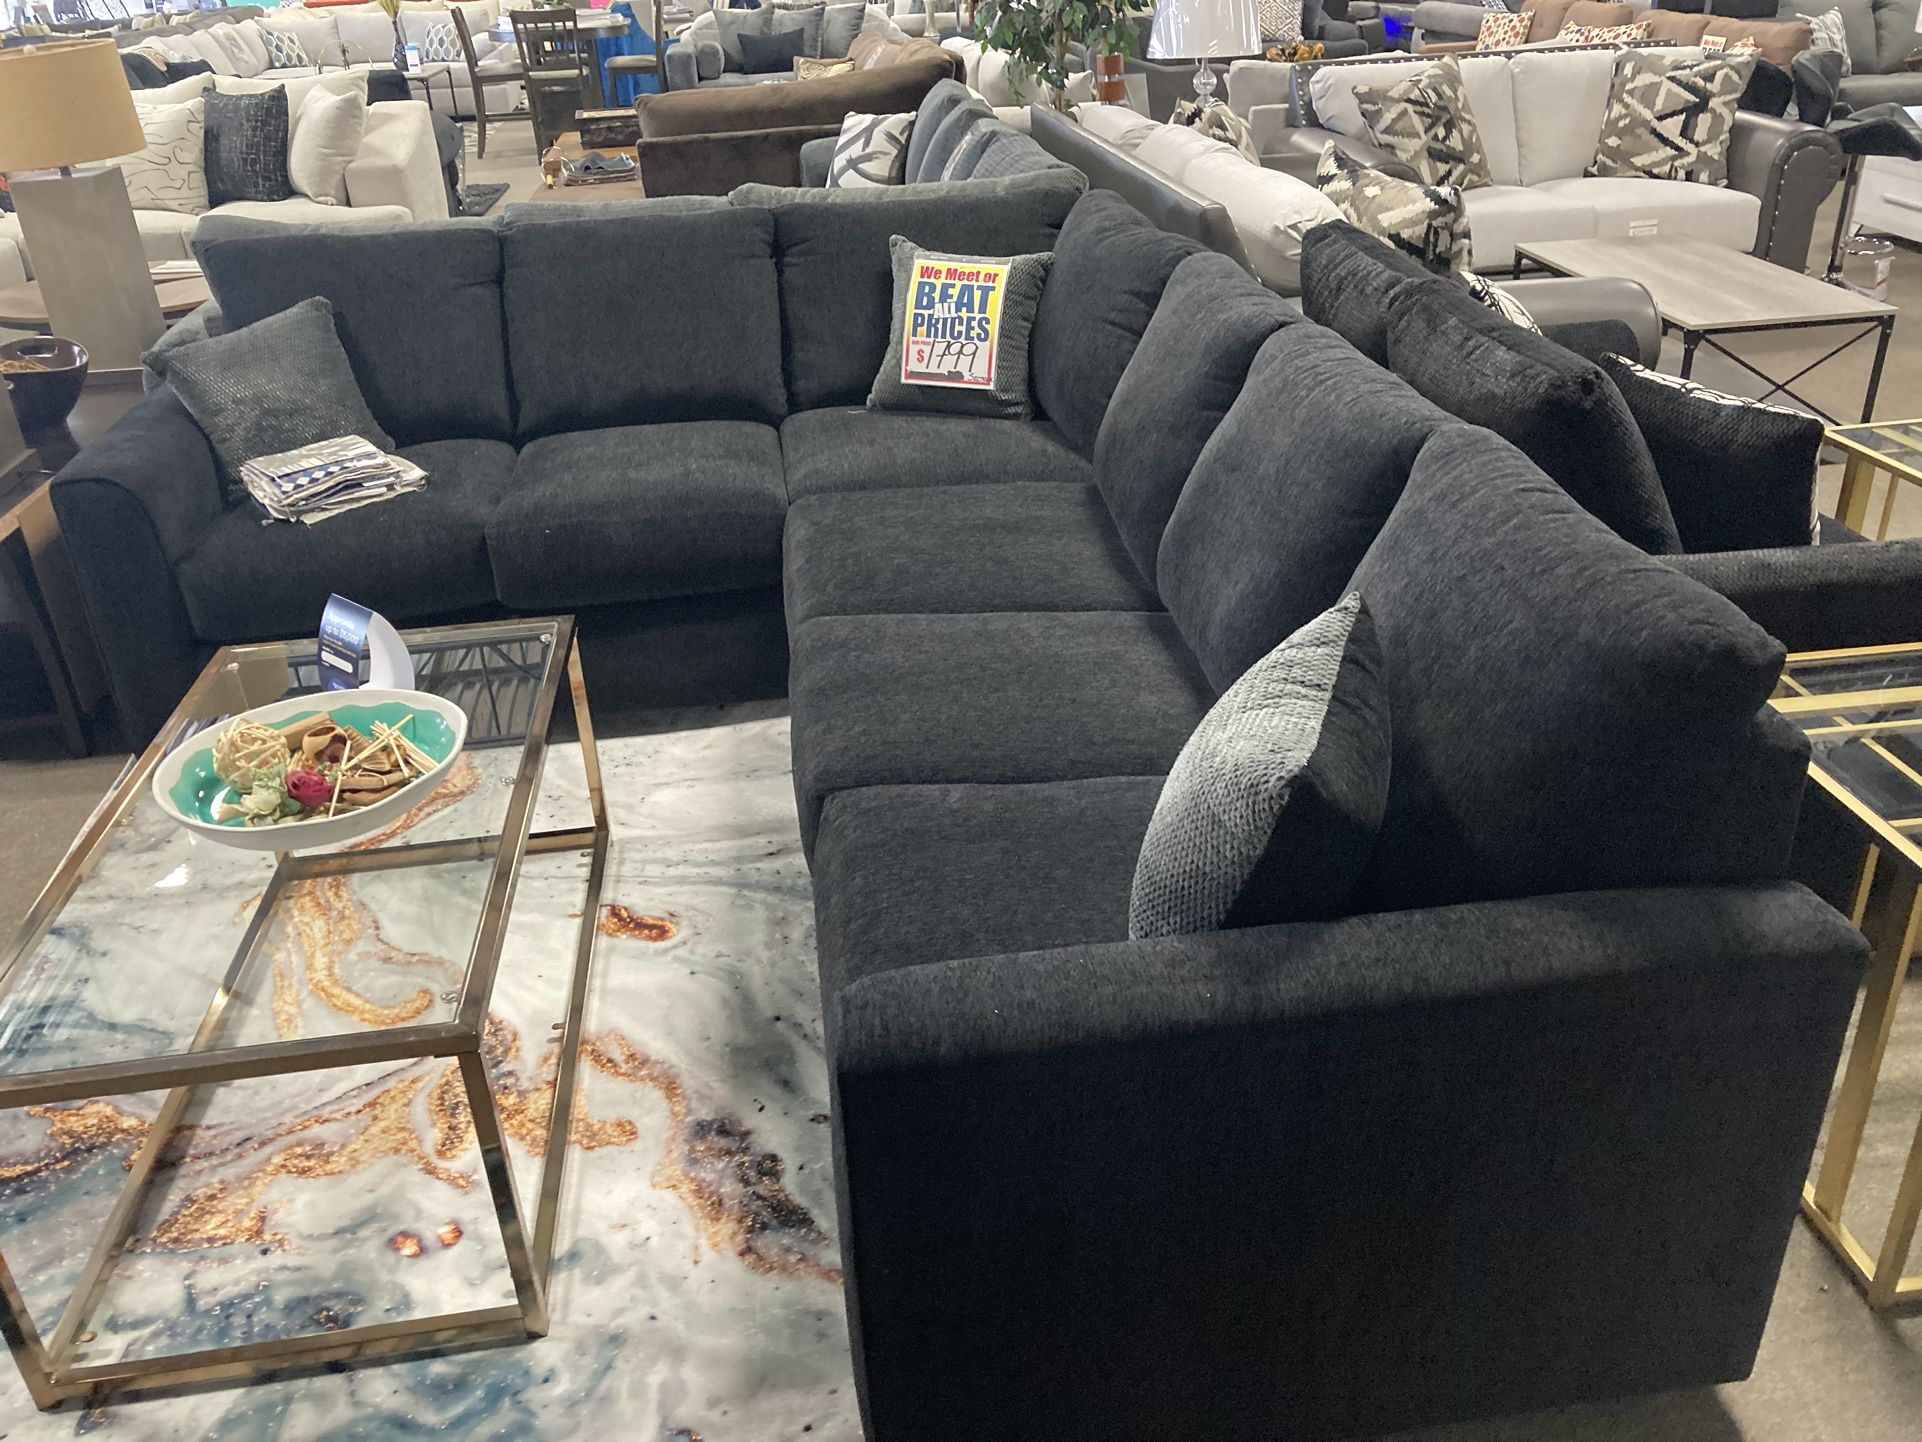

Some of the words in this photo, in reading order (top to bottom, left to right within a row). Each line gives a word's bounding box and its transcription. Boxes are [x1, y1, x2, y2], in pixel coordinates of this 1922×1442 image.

[920, 265, 943, 280] We
[945, 267, 981, 283] Meet
[983, 272, 999, 284] or
[914, 280, 996, 314] BEAT
[934, 302, 959, 319] ALL
[912, 312, 991, 343] PRICES
